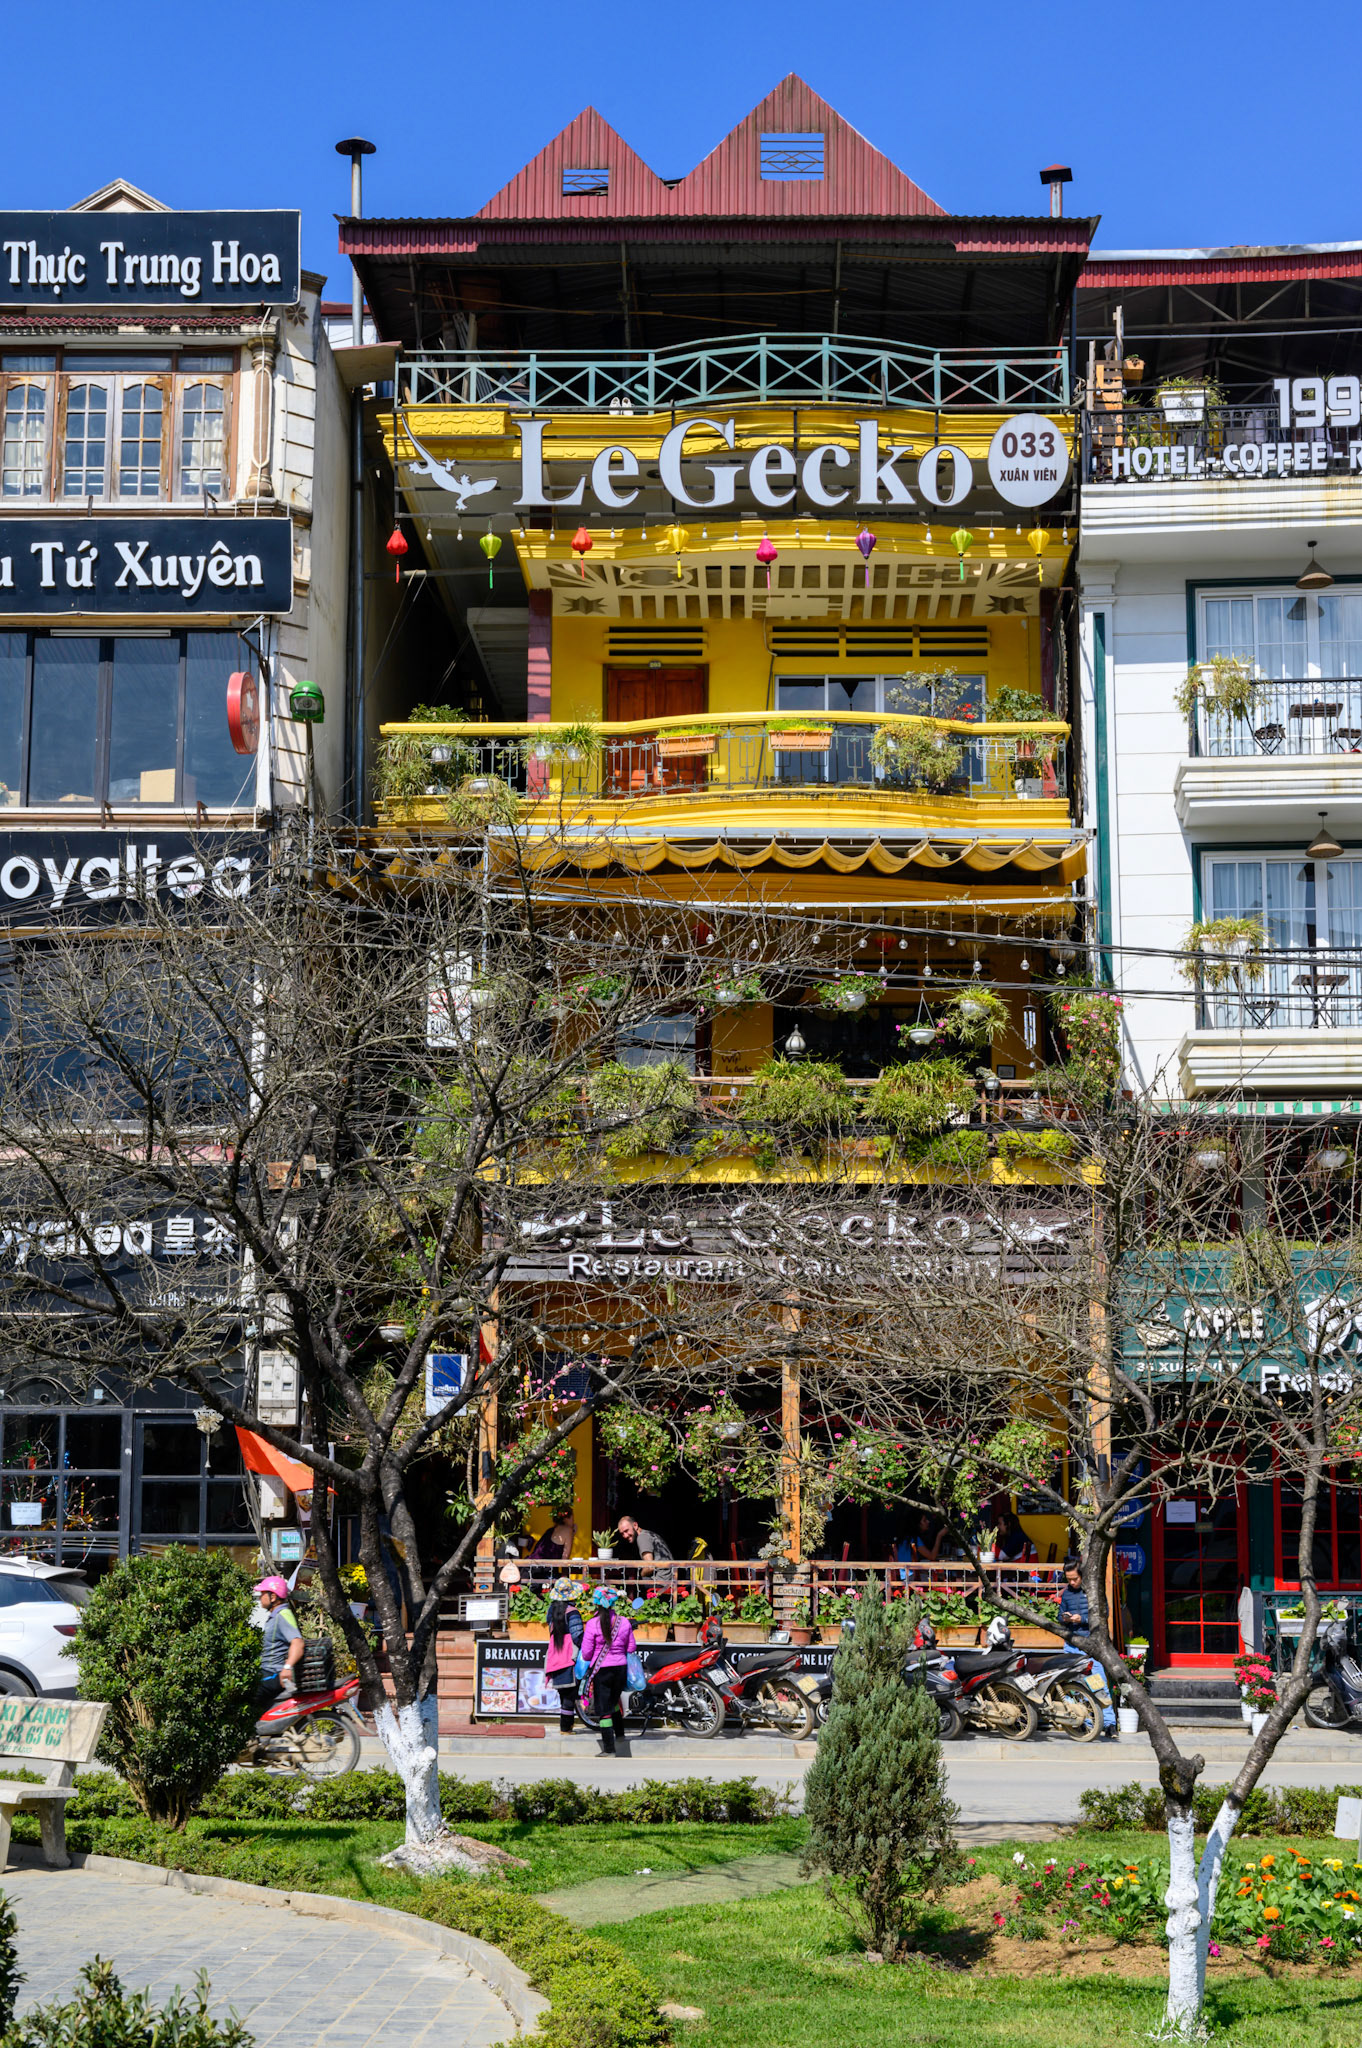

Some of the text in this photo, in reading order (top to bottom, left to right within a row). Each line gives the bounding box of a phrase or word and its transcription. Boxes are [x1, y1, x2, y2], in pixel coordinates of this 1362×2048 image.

[3, 240, 281, 297] Thực Trung Hoa
[1273, 376, 1361, 428] 199
[1001, 432, 1056, 457] 033
[511, 417, 974, 509] Le Gecko
[1000, 467, 1058, 482] XUÂN VIÊN
[30, 540, 98, 588] Tứ
[114, 540, 263, 598] Xuyên
[568, 1254, 743, 1278] Restaurant
[485, 1648, 541, 1661] BREAKFAST
[21, 1705, 70, 1725] XANH
[26, 1726, 44, 1745] 63
[45, 1727, 64, 1747] 63
